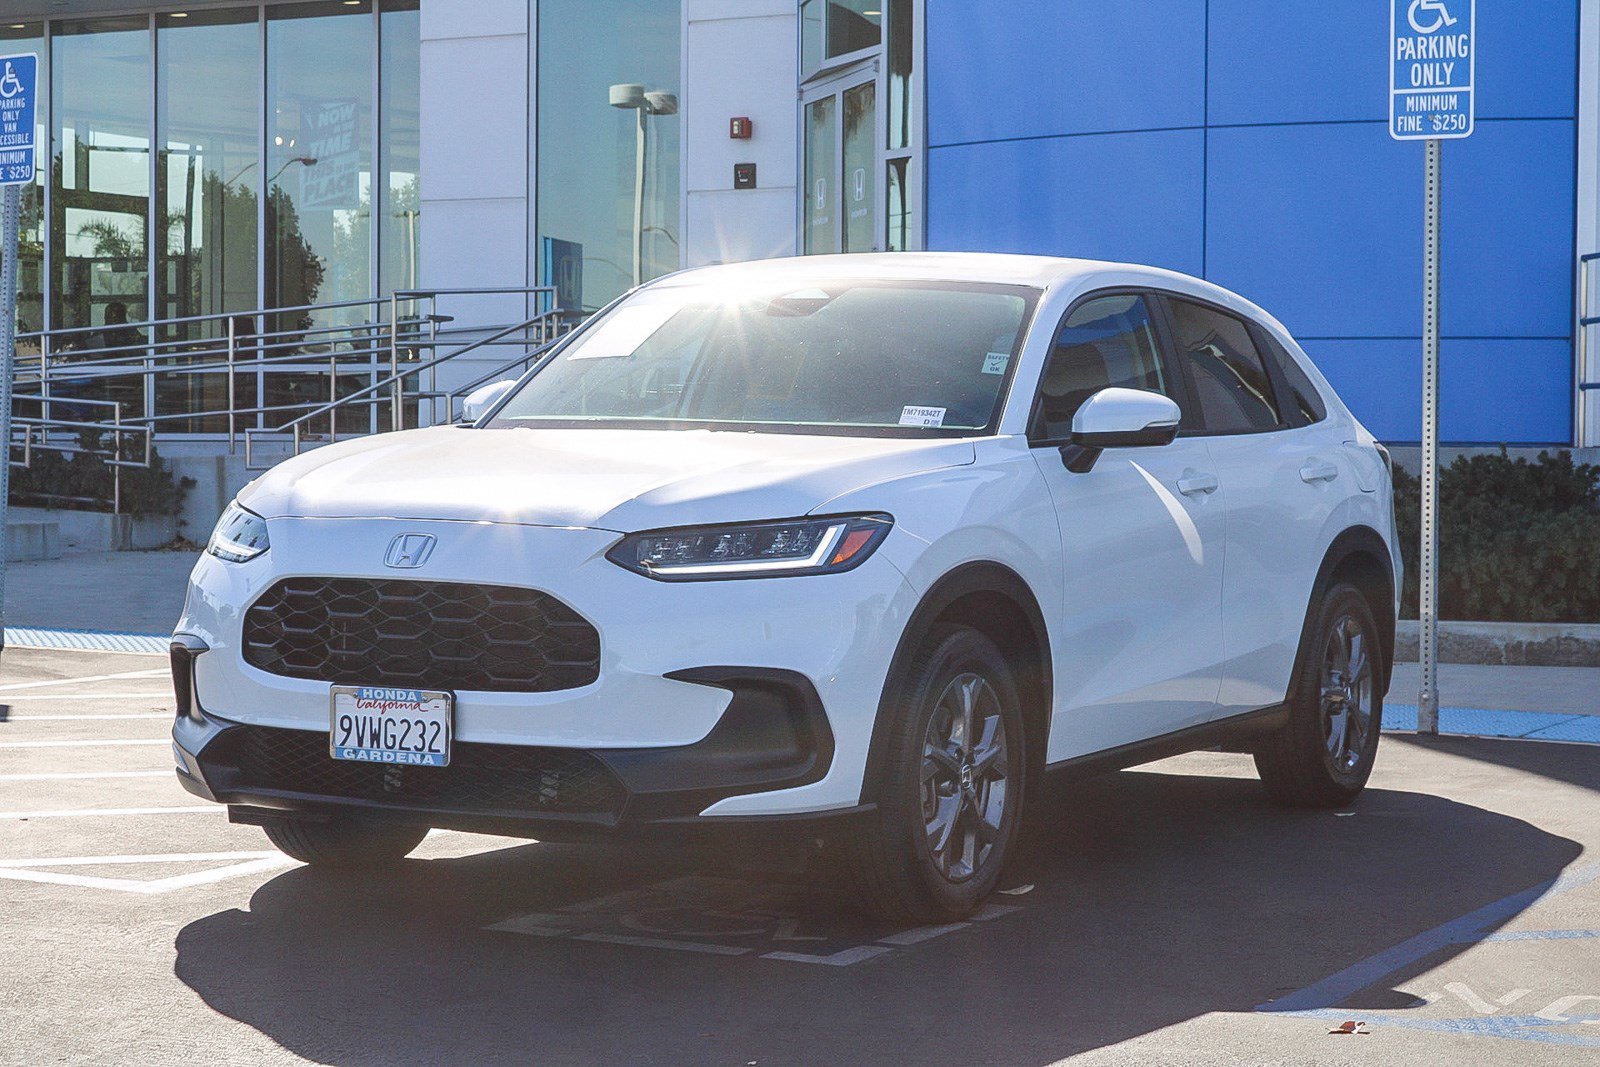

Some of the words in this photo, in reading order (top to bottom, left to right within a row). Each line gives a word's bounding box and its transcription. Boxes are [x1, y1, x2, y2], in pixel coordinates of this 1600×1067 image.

[1397, 33, 1468, 60] PARKING
[1411, 62, 1454, 87] ONLY
[1406, 94, 1457, 112] MINIMUM
[2, 110, 20, 121] ONLY
[318, 103, 356, 128] NOW
[1397, 115, 1423, 132] FINE
[1432, 114, 1466, 132] $250
[4, 122, 17, 133] VAN
[0, 133, 29, 145] CESSIBLE
[309, 131, 353, 158] TIME
[0, 151, 25, 164] INIMUM
[9, 165, 30, 179] $250
[362, 688, 419, 701] HONDA
[356, 698, 429, 714] California
[339, 714, 441, 753] 9VWG232
[342, 748, 435, 765] GARDENA
